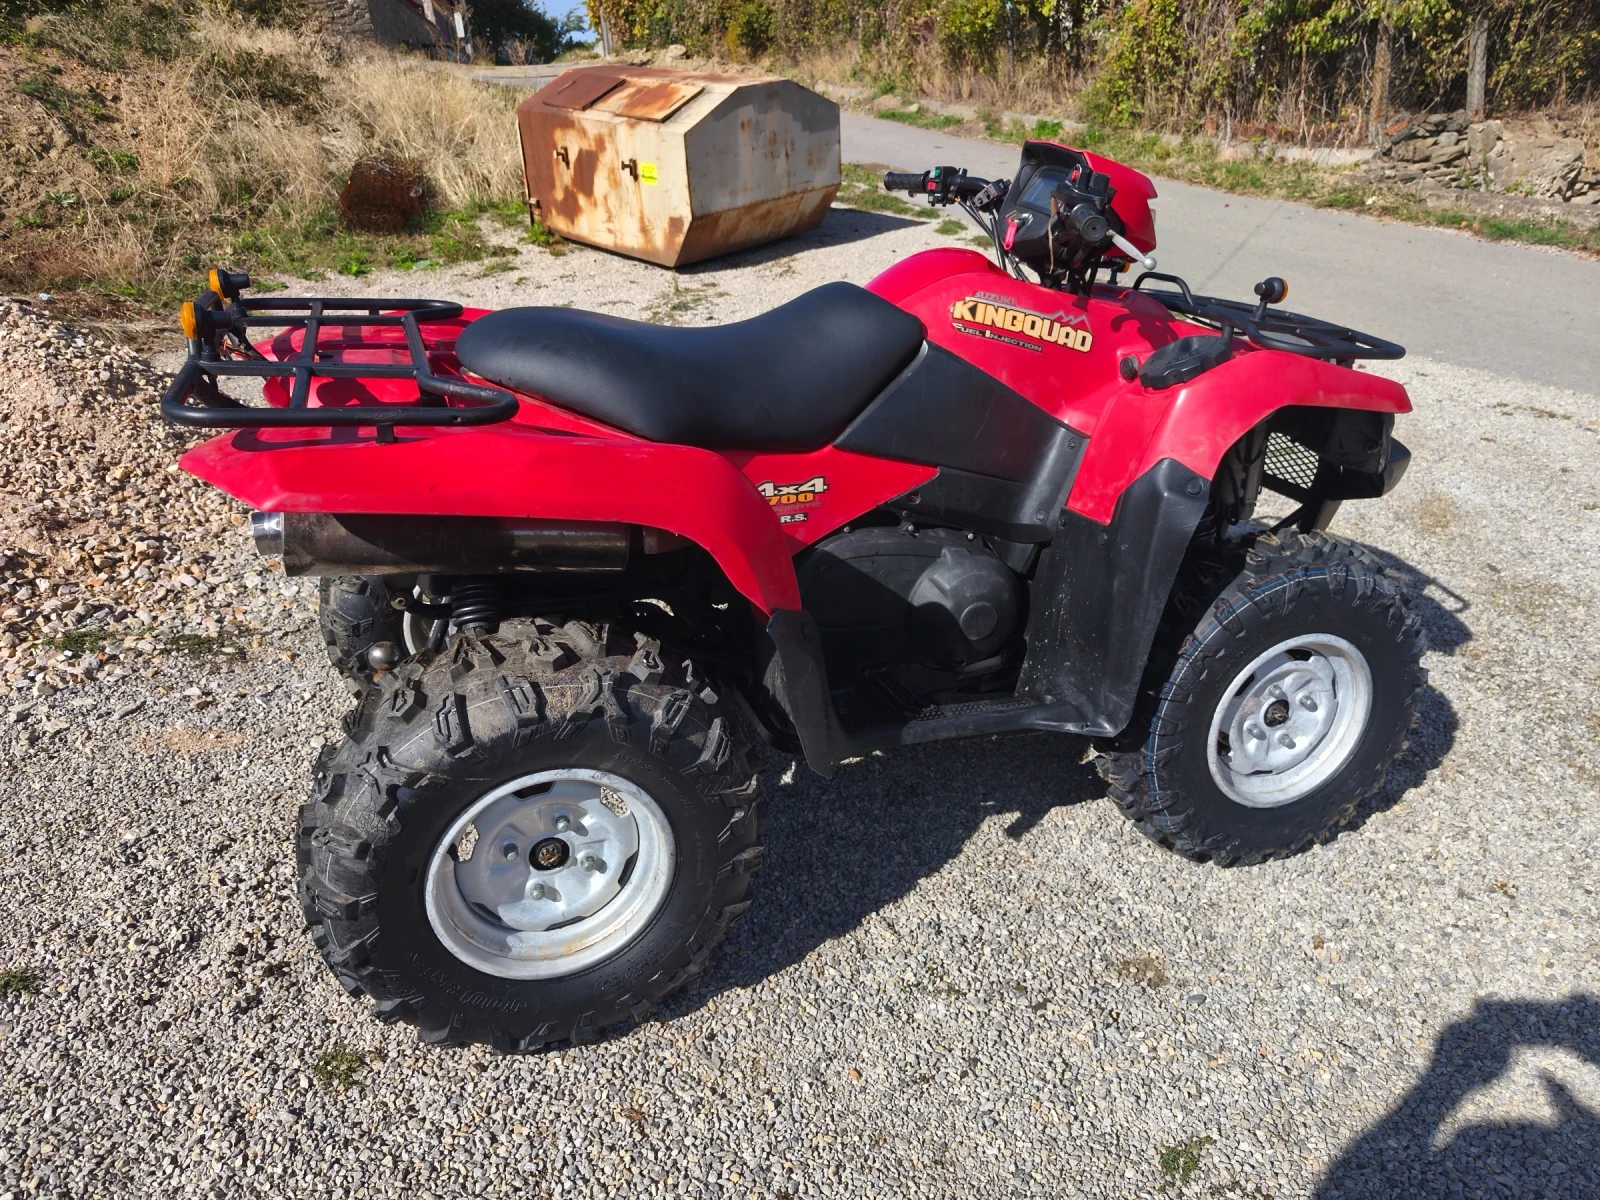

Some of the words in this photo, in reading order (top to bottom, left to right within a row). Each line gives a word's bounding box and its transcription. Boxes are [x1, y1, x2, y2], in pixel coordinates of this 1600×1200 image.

[975, 290, 1016, 307] SUZUKI
[952, 300, 1093, 352] KINGQUAD
[952, 322, 982, 337] FUEL
[985, 330, 1042, 352] INJECTION
[765, 492, 814, 506] 700
